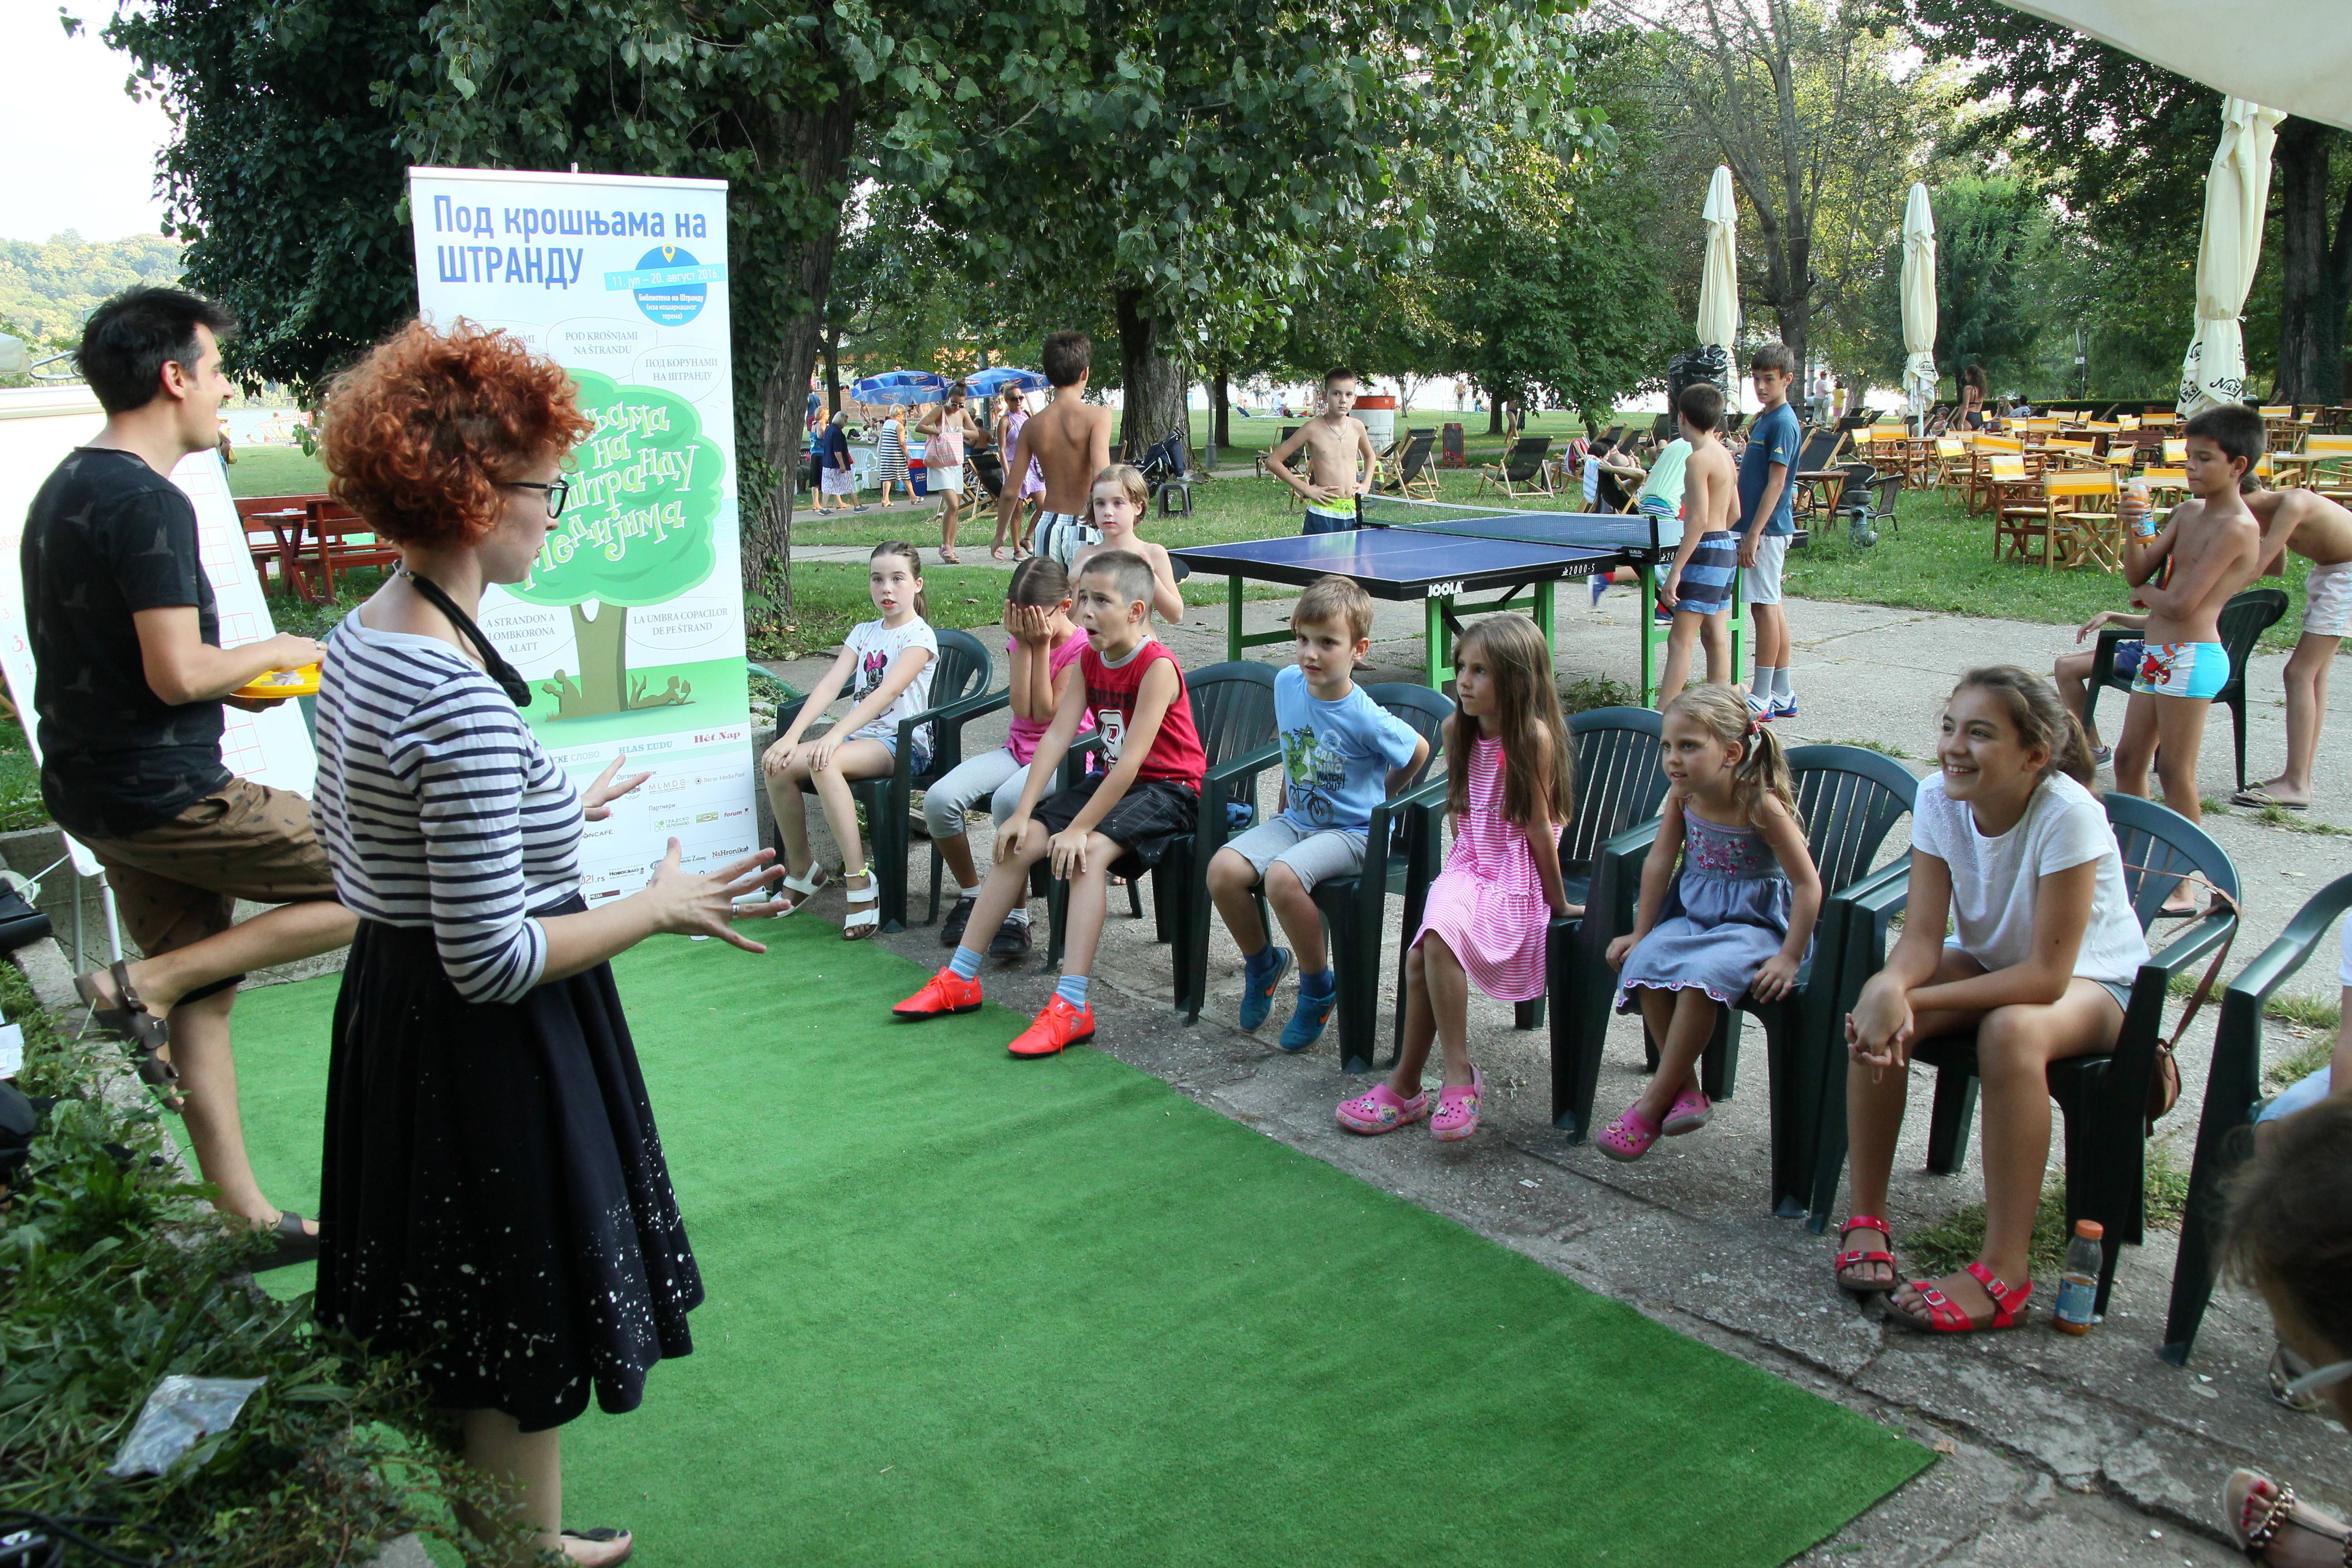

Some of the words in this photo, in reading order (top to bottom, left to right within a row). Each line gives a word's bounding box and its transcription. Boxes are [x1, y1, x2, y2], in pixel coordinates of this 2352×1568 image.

[434, 195, 494, 239] Под
[505, 208, 665, 243] крошњама
[675, 213, 706, 238] на
[437, 245, 584, 290] ШТРАНДУ
[612, 276, 626, 287] 11.
[627, 275, 640, 289] јул
[651, 273, 665, 284] 20.
[667, 273, 695, 284] август
[697, 268, 720, 280] 2016.
[638, 294, 671, 302] Библиотека
[680, 294, 704, 303] Штранду
[662, 313, 683, 321] терена)
[565, 332, 585, 340] POD
[587, 330, 638, 342] KROŠNJAMI
[573, 346, 587, 354] NA
[588, 344, 632, 354] ŠTRANDU
[646, 359, 666, 369] ПОД
[667, 358, 718, 368] КОРУНАМИ
[653, 372, 667, 381] НА
[669, 372, 712, 382] ШТРАНДУ
[1666, 552, 1678, 561] 20
[1427, 581, 1464, 598] JOOLA
[485, 619, 493, 627] A
[494, 614, 547, 626] STRANDON
[548, 614, 555, 622] A
[633, 615, 645, 624] LA
[646, 611, 679, 623] UMBRA
[680, 608, 728, 620] COPACILOR
[488, 626, 555, 641] LOMBKORONA
[652, 626, 665, 636] DE
[666, 626, 677, 634] PE
[677, 621, 713, 633] ŠTRAND
[508, 642, 539, 653] ALATT
[694, 733, 717, 743] Hét
[718, 731, 741, 741] Nap
[618, 744, 644, 755] HLAS
[647, 740, 673, 750] ĽUDU
[554, 755, 568, 763] СКЕ
[570, 751, 600, 762] СЛОВО
[1315, 745, 1348, 764] CRAZY
[1316, 762, 1343, 774] DINO
[649, 803, 677, 812] Партнери:
[712, 847, 747, 857] NsHronika
